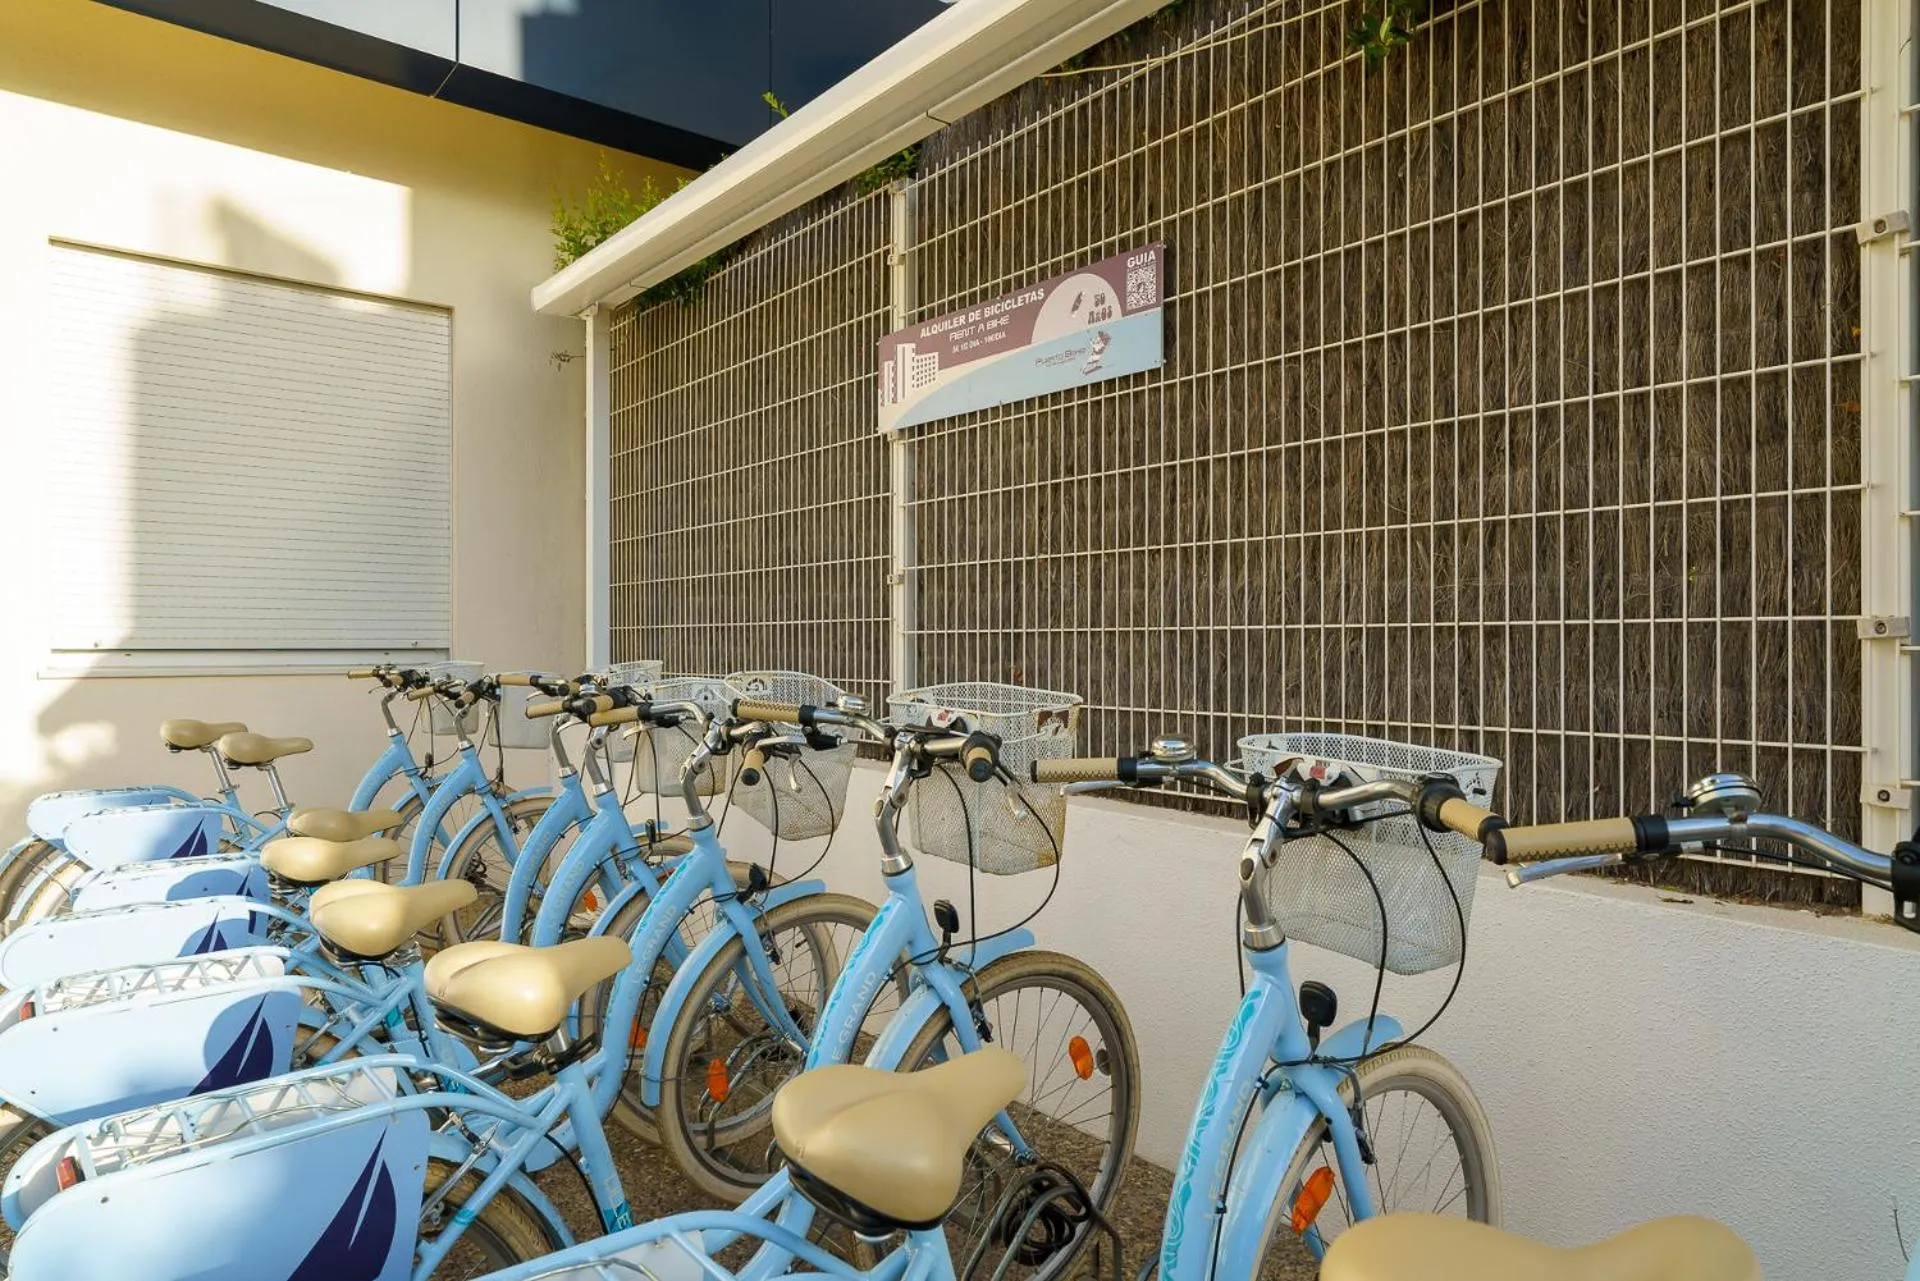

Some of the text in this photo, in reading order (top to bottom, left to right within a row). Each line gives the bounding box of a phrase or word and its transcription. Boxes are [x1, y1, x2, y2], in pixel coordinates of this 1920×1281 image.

[1127, 249, 1156, 268] GUIA
[920, 315, 966, 339] ALQUILER
[968, 309, 982, 323] DE
[984, 287, 1045, 318] BICICLETAS
[949, 326, 976, 342] RENT
[977, 323, 985, 333] A
[986, 315, 1011, 330] BIKE
[831, 970, 877, 1061] EGRAND
